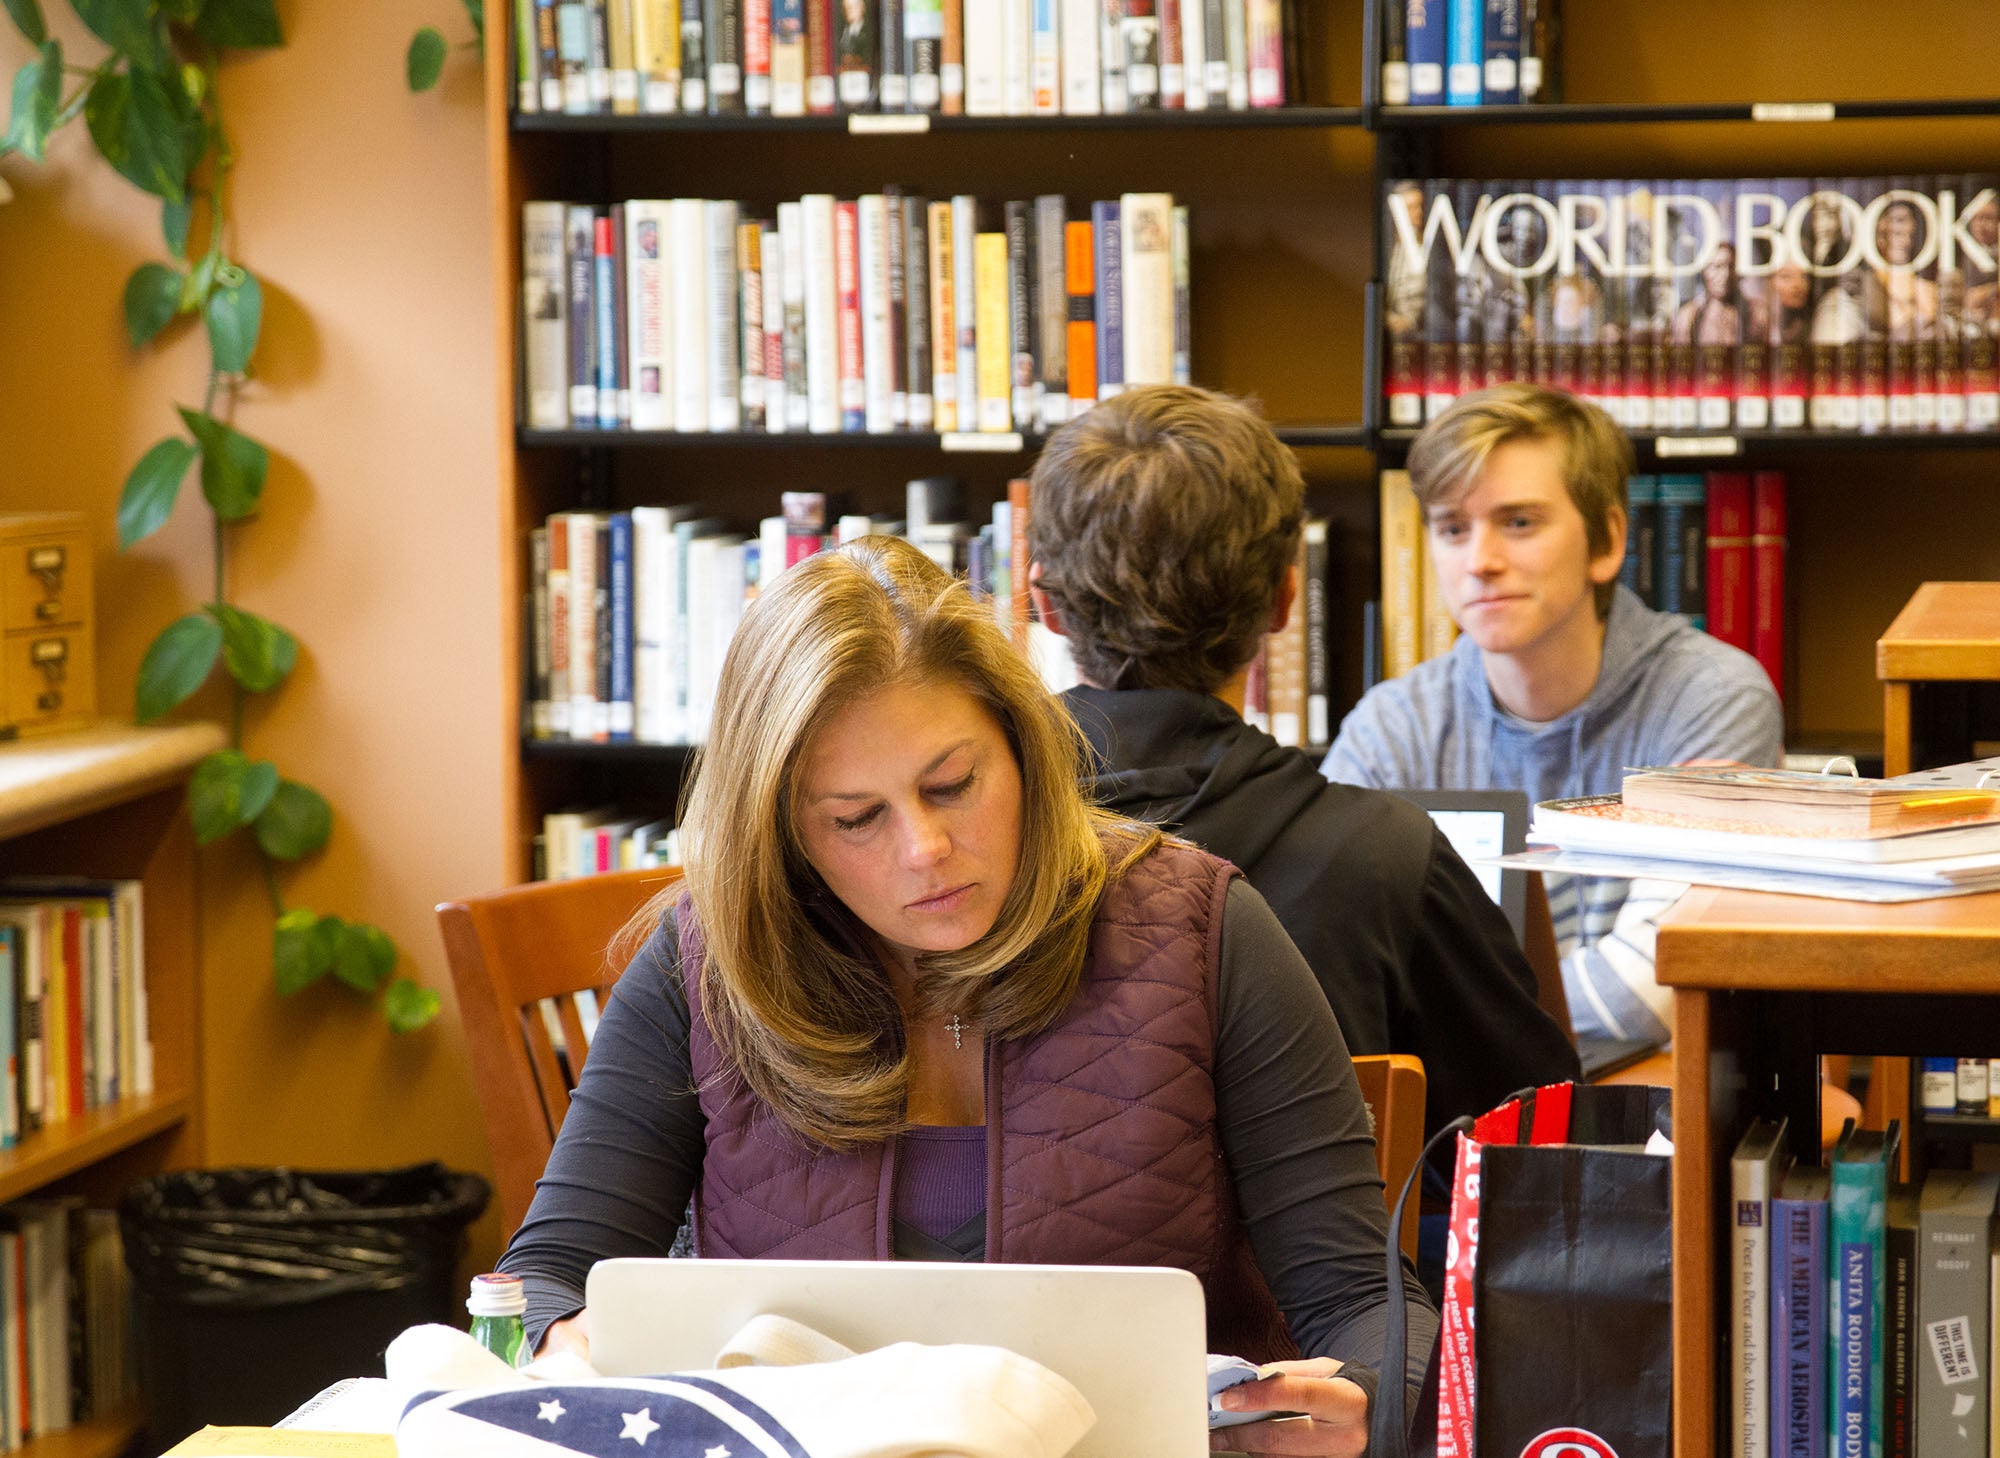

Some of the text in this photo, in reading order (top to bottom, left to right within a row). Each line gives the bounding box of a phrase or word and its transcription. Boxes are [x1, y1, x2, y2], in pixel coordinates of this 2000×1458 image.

[1389, 188, 1998, 278] WORLD BOOK
[1791, 1208, 1810, 1245] THE
[1931, 1232, 1975, 1242] REINHART
[1743, 1239, 1755, 1268] Peer
[1898, 1257, 1906, 1281] JOHN
[1446, 1275, 1456, 1299] live
[1743, 1272, 1754, 1286] to
[1848, 1249, 1863, 1309] ANITA
[1450, 1300, 1464, 1330] near
[1743, 1290, 1755, 1318] Peer
[1791, 1253, 1810, 1351] AMERICAN
[1897, 1285, 1906, 1328] KENNETH
[1445, 1335, 1456, 1361] over
[1456, 1331, 1469, 1354] the
[1743, 1321, 1756, 1348] and
[1950, 1321, 1971, 1375] THIS TIME IS
[1743, 1352, 1756, 1375] the
[1847, 1314, 1862, 1398] RODDICK
[1896, 1332, 1905, 1386] GALBRAITH
[1933, 1324, 1960, 1378] DIFFERENT
[1449, 1363, 1460, 1383] the
[1461, 1355, 1475, 1394] ocean
[1455, 1385, 1467, 1417] water
[1743, 1379, 1756, 1418] Music
